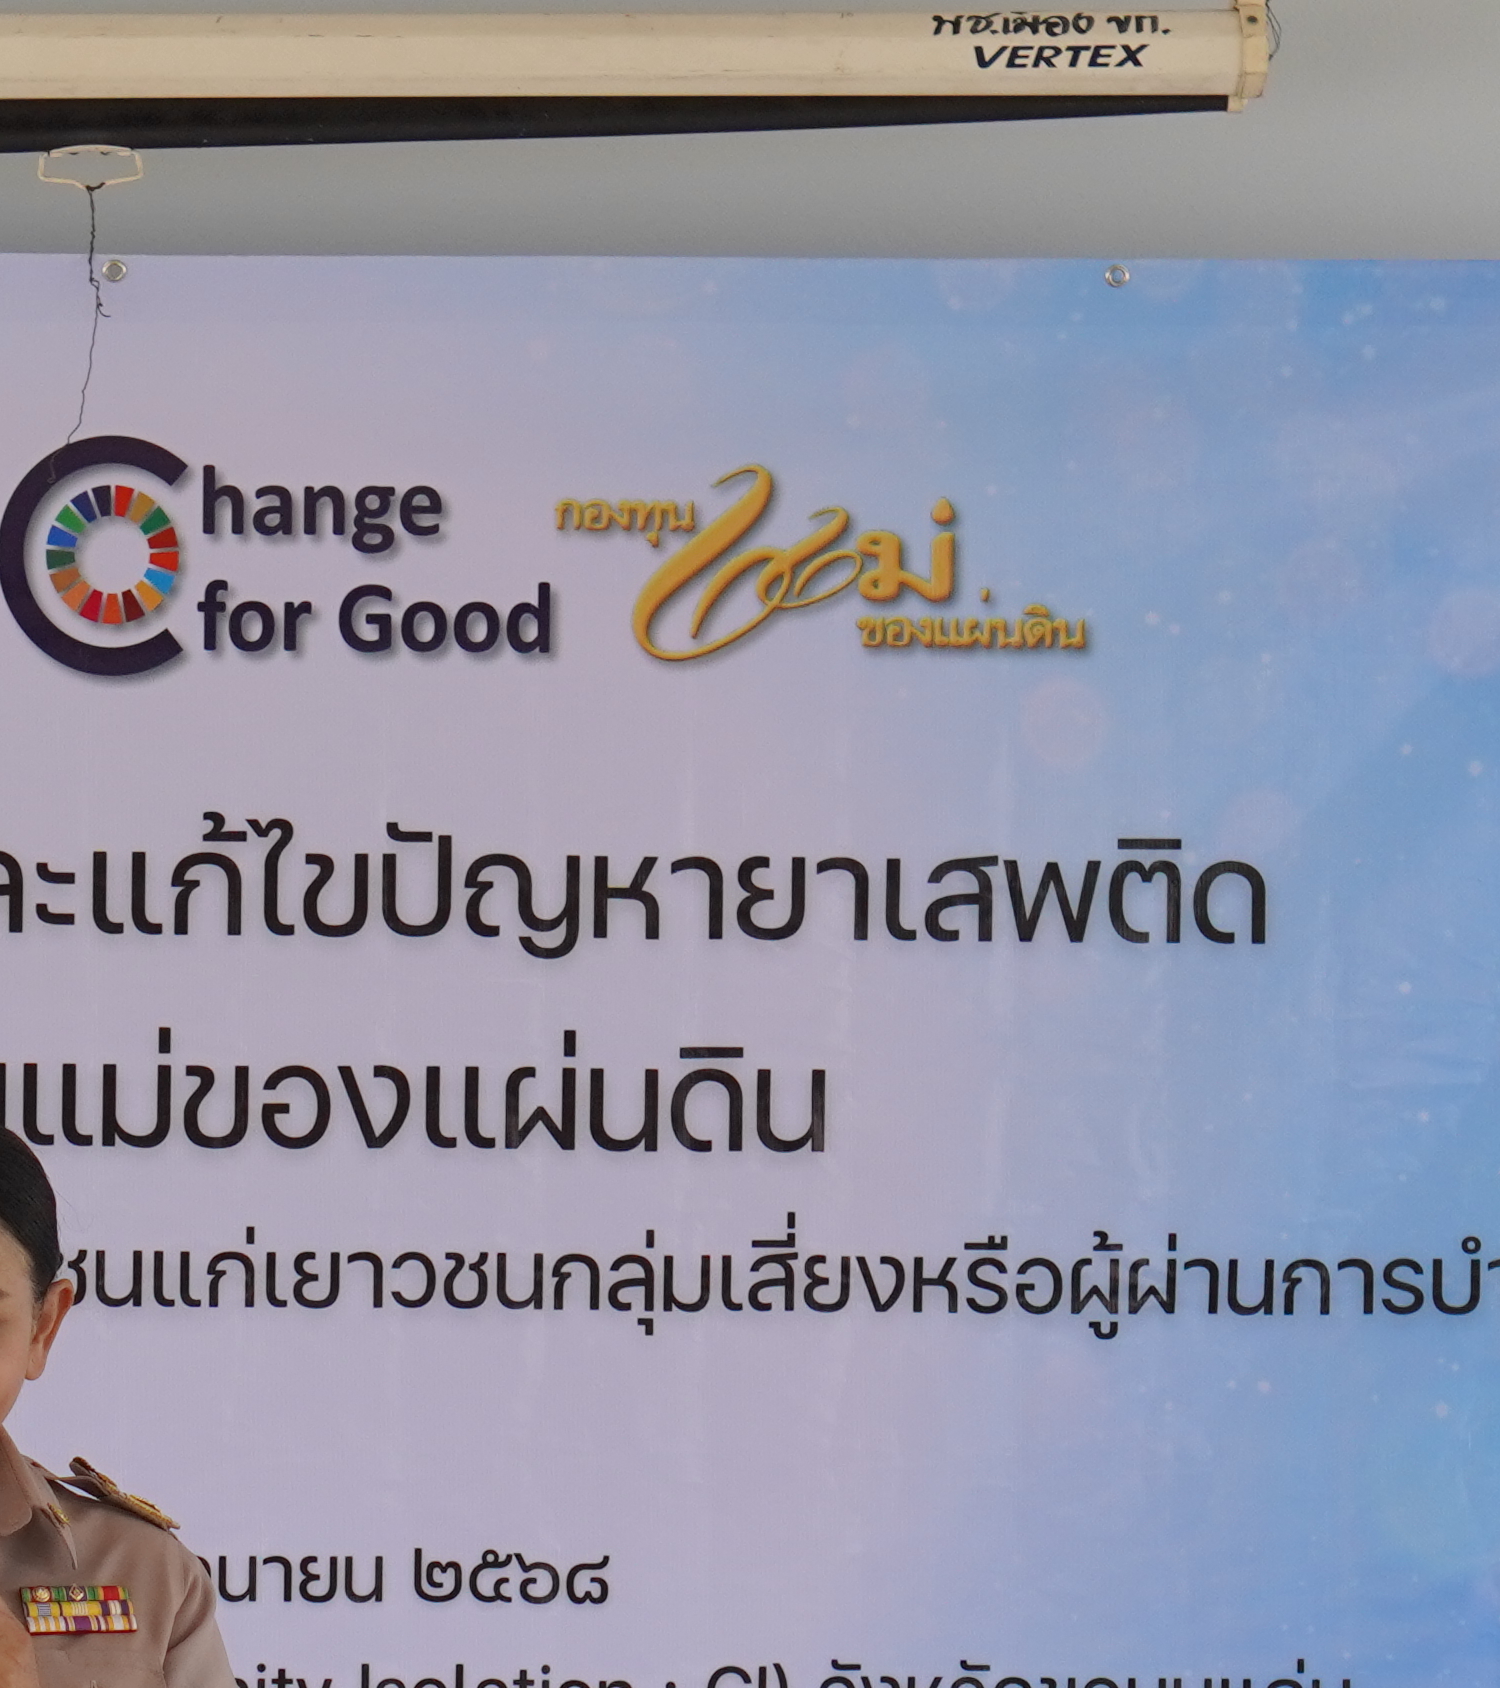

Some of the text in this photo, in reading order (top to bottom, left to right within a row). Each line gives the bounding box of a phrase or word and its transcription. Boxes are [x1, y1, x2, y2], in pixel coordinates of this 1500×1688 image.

[974, 44, 1149, 69] VERTEX
[554, 498, 695, 548] กองทุน
[197, 580, 551, 654] for Good
[857, 587, 1086, 650] ของแผ่นดิน
[198, 1555, 383, 1603] นายน
[413, 1547, 610, 1605] ๒๕๖๘
